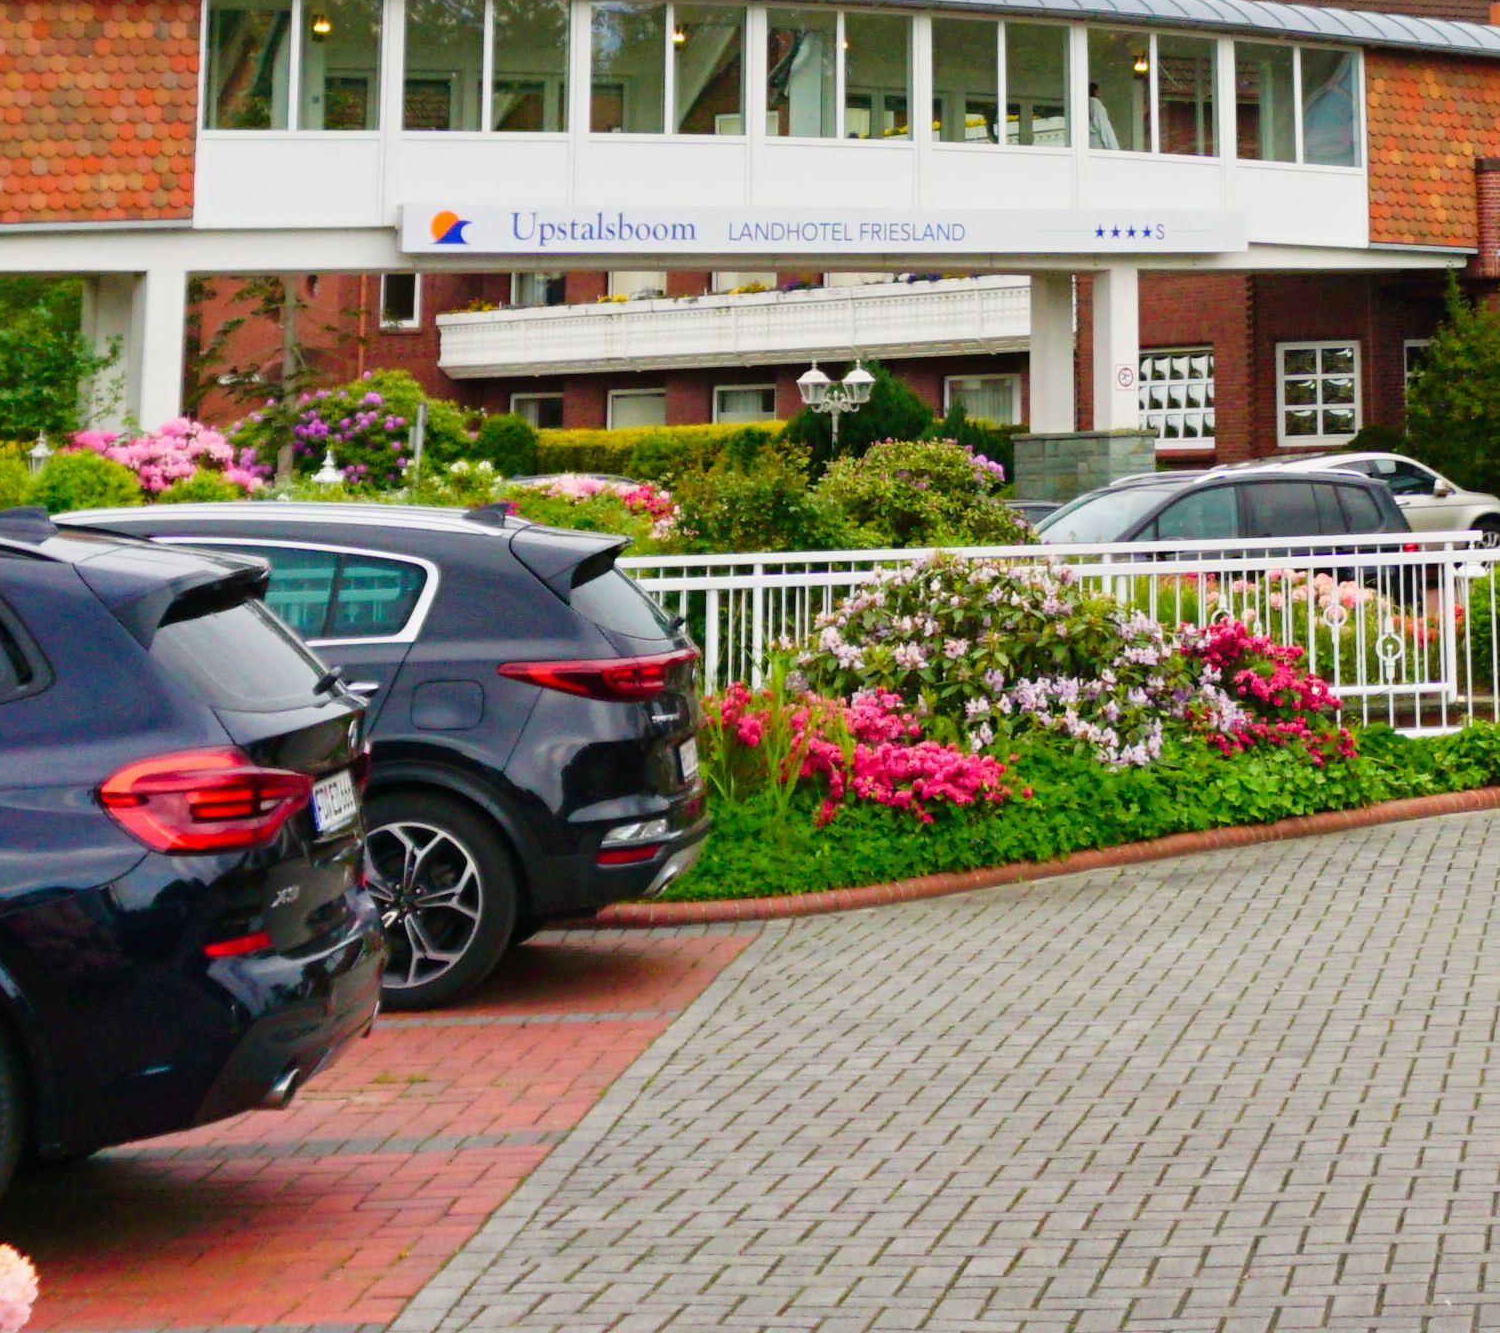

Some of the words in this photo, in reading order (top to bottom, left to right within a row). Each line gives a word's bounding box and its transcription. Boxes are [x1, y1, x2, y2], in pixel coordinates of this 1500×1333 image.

[511, 211, 697, 247] Upstalsboom
[729, 222, 853, 242] LANDHOTEL
[859, 223, 966, 242] FRIESLAND
